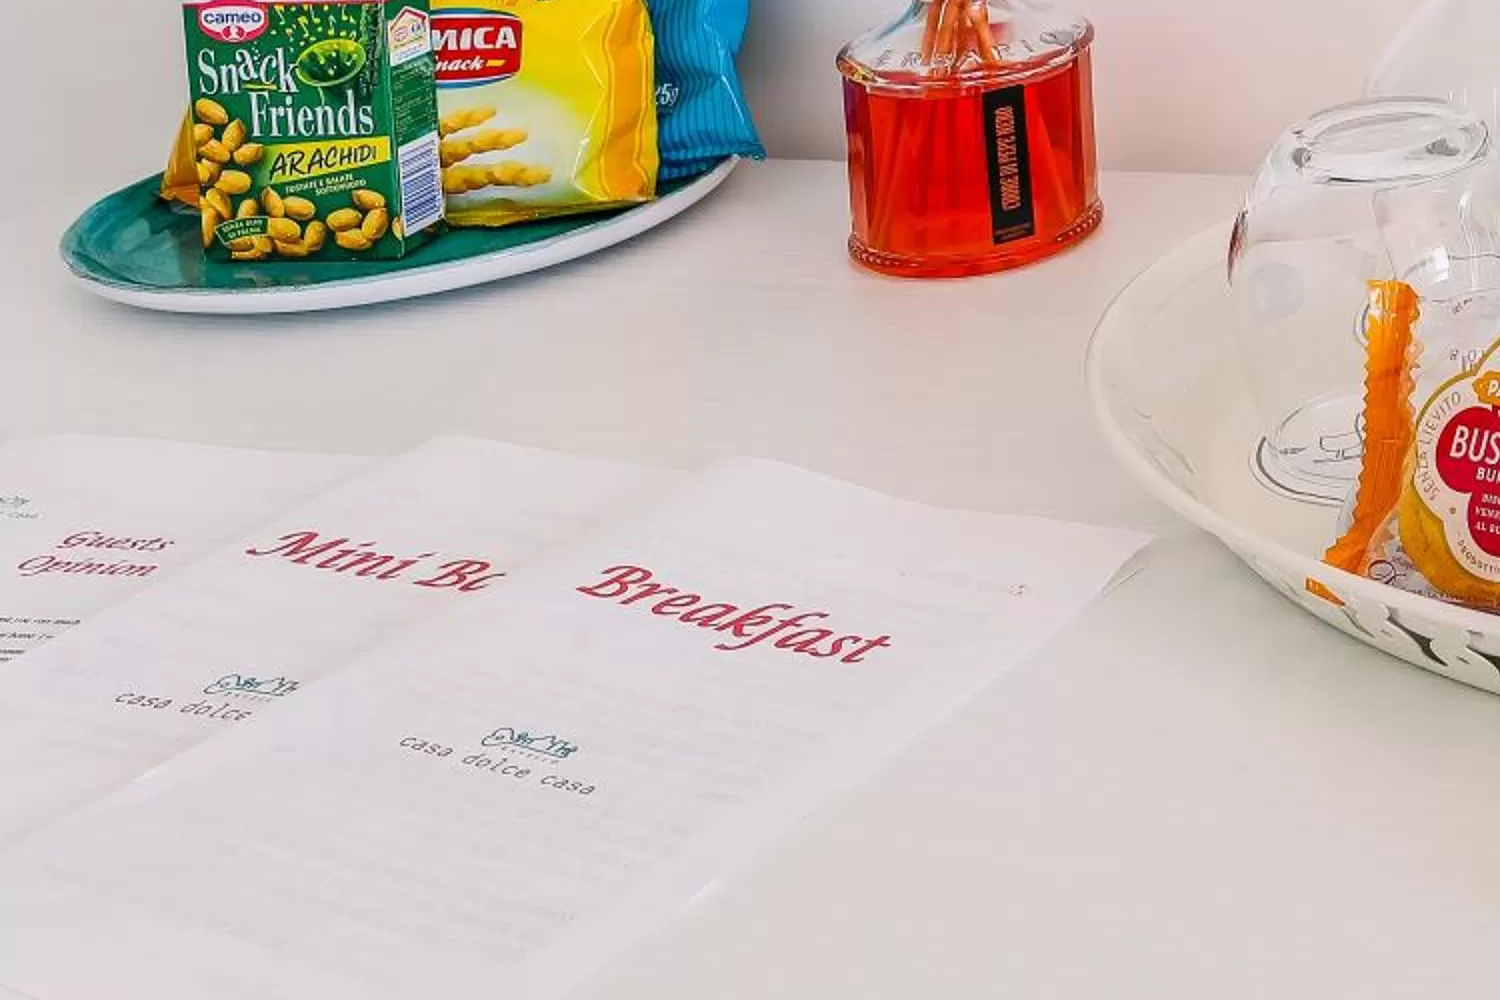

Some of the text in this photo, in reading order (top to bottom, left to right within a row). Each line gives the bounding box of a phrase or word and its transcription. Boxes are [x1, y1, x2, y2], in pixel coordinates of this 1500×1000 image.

[203, 11, 262, 24] cameo
[198, 47, 299, 95] Snack
[433, 55, 484, 72] nack
[250, 89, 375, 138] Friends
[270, 144, 377, 180] ARACHIDI
[57, 531, 175, 551] Guests
[246, 530, 432, 582] Mini
[17, 555, 159, 577] Opinion
[575, 564, 892, 664] Breakfast
[114, 690, 253, 721] casa dolce
[399, 732, 454, 758] casa
[460, 750, 531, 781] dolce
[540, 771, 597, 796] casa
